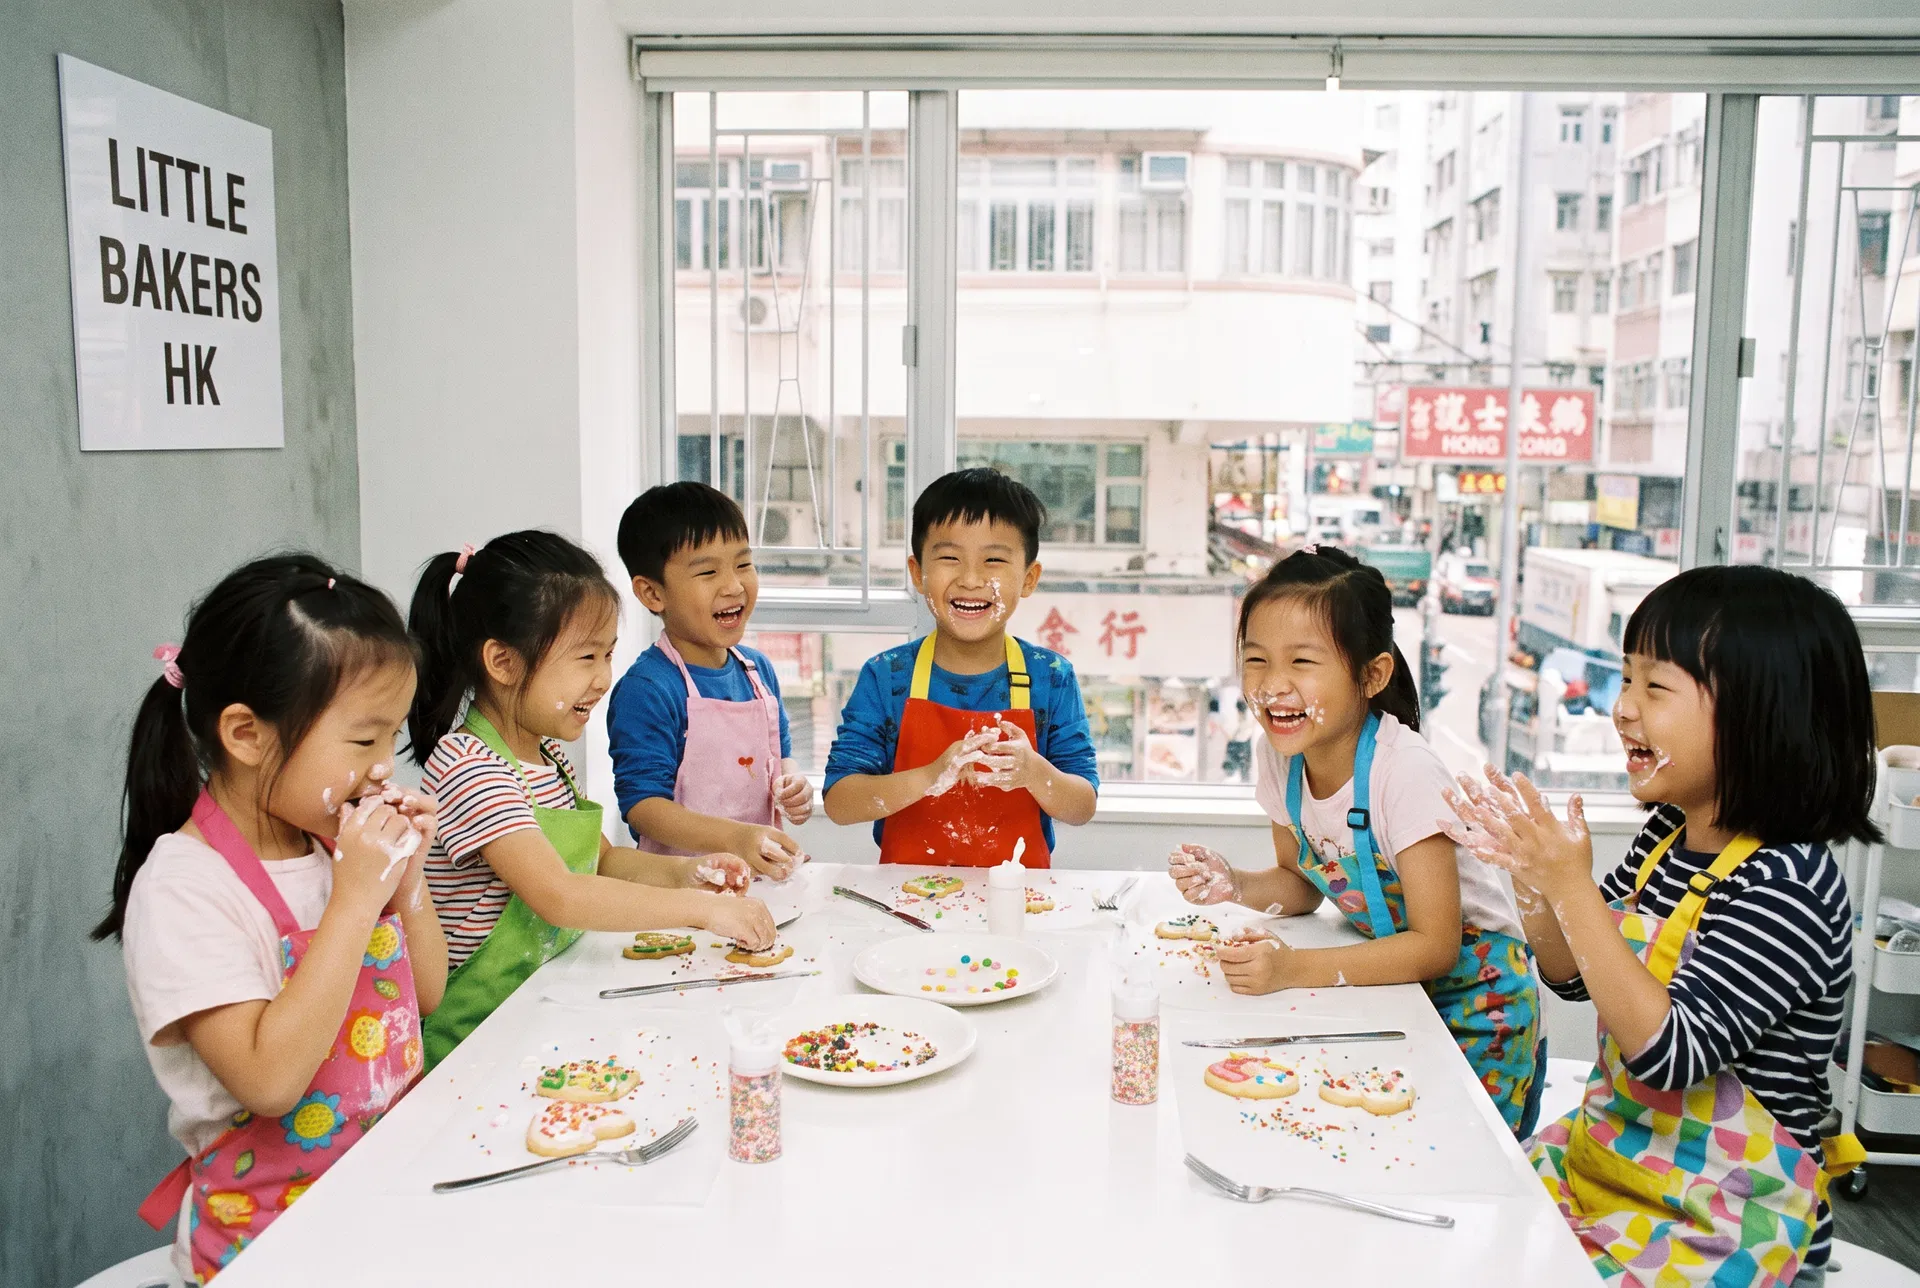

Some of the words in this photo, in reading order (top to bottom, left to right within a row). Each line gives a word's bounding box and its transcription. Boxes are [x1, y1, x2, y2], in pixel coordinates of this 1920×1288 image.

[108, 137, 248, 235] LITTLE
[99, 235, 262, 323] BAKERS
[163, 341, 221, 406] HK
[1442, 436, 1499, 454] HONG
